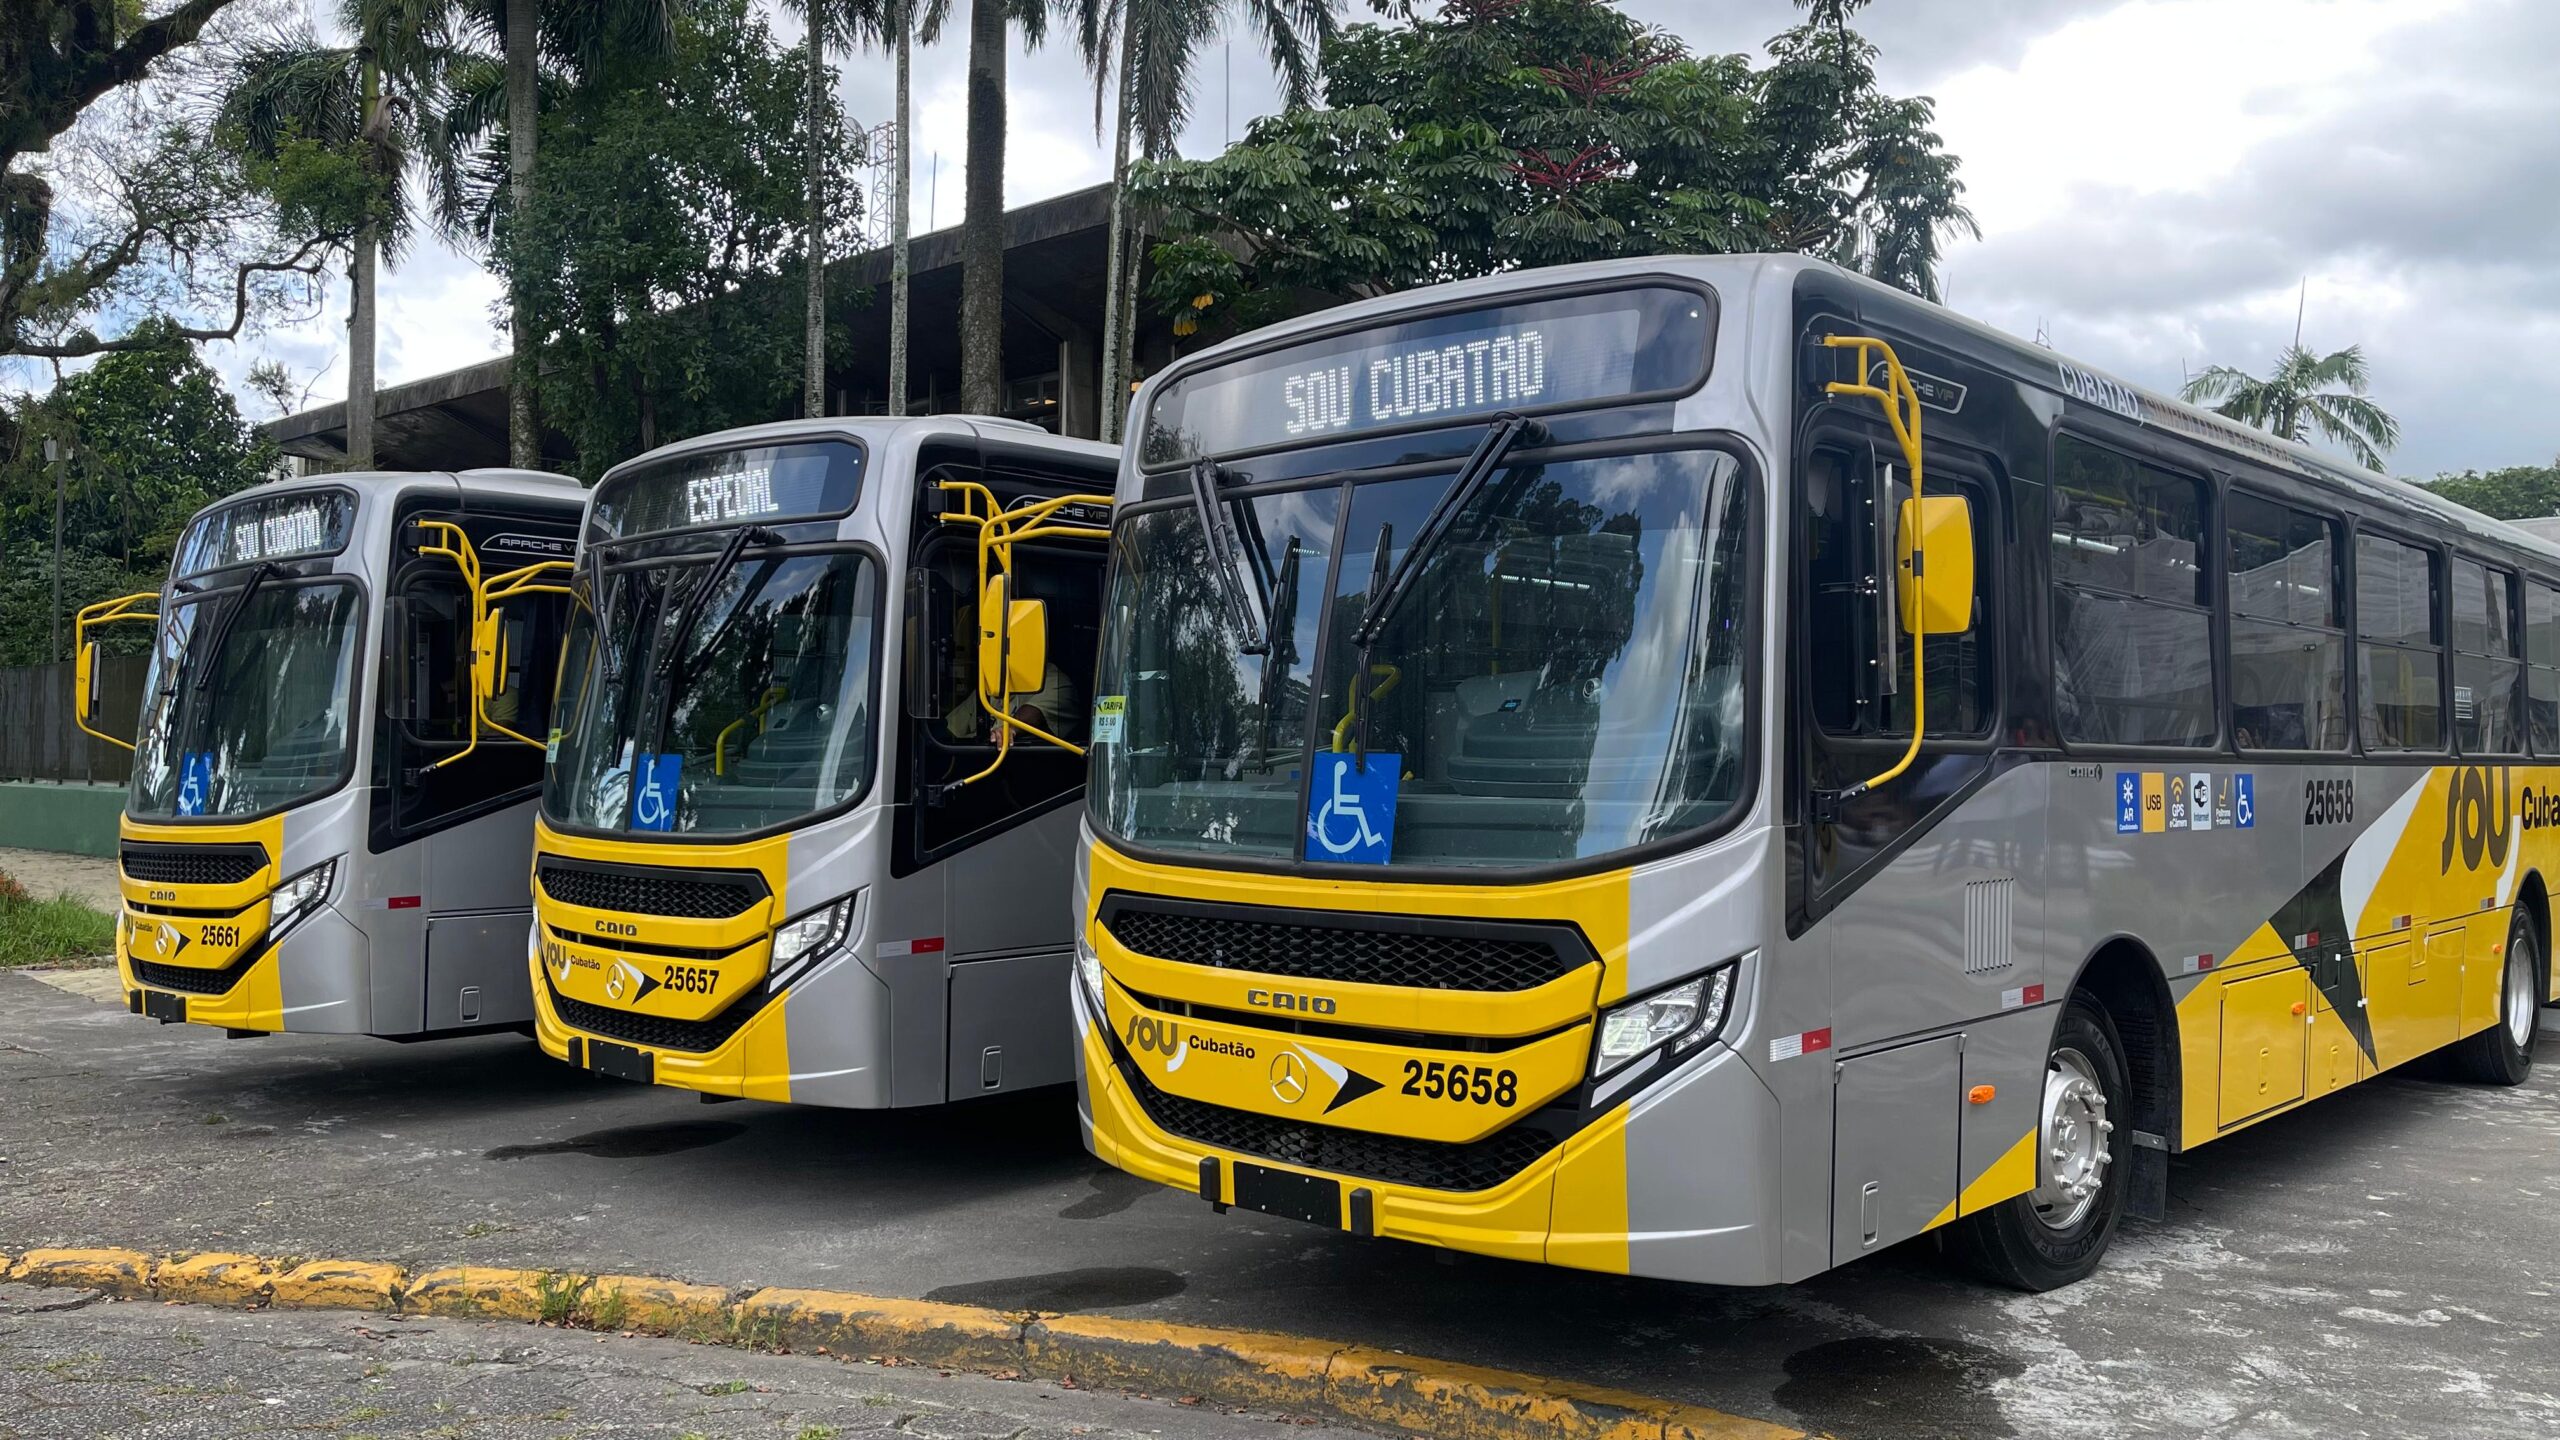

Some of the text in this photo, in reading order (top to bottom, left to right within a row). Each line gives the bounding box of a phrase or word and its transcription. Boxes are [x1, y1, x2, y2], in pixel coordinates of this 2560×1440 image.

[1284, 331, 1543, 434] SOU CUBATAO
[688, 468, 779, 523] ESPECIAL
[235, 508, 320, 561] SOU CUBATAO
[500, 538, 577, 552] APACHE VI
[1103, 702, 1123, 711] TARIFA
[2146, 794, 2162, 811] USB
[2172, 803, 2185, 817] GPS
[2304, 779, 2353, 825] 25658
[2123, 807, 2134, 822] AR
[150, 891, 176, 901] CAIO
[201, 925, 240, 948] 25661
[595, 920, 637, 936] CAIO
[571, 954, 600, 970] Cubatão
[663, 965, 720, 995] 25657
[1247, 989, 1336, 1015] CAIO
[1188, 1034, 1256, 1060] Cubatão
[1401, 1059, 1519, 1108] 25658
